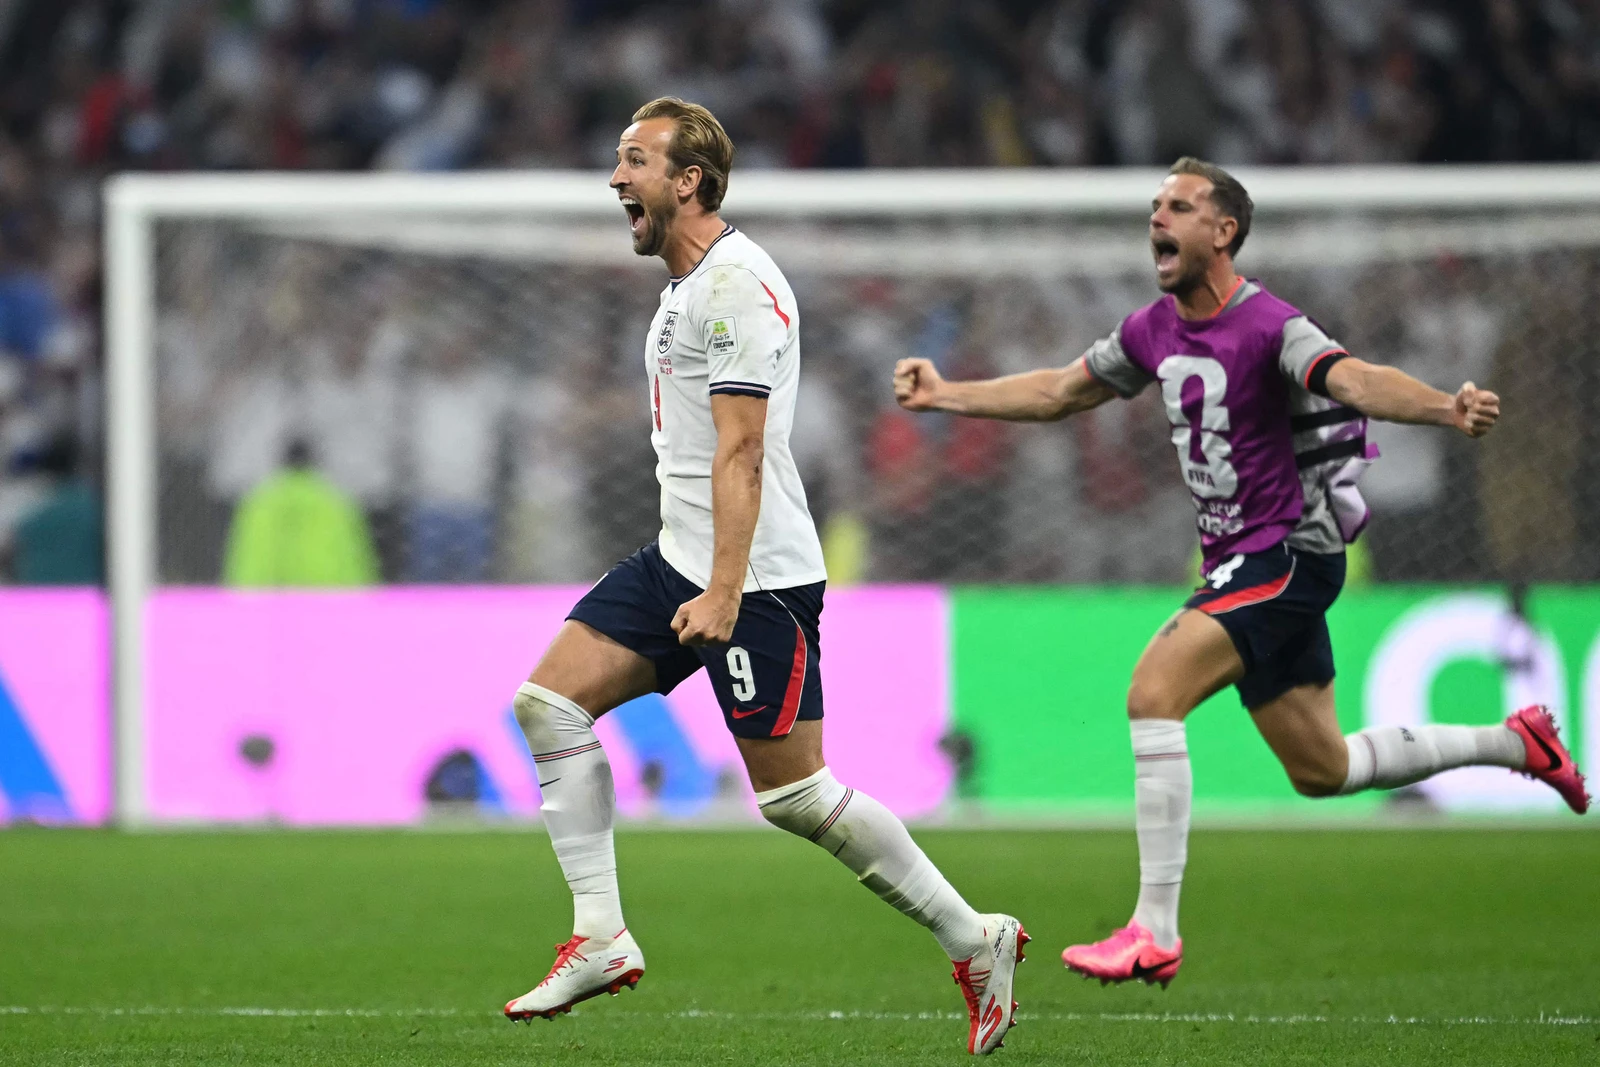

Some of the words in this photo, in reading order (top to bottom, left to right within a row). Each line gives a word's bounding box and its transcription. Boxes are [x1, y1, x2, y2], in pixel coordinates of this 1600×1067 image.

[713, 340, 734, 349] EDUCATION
[1187, 469, 1215, 488] FIFA
[726, 646, 756, 702] 9
